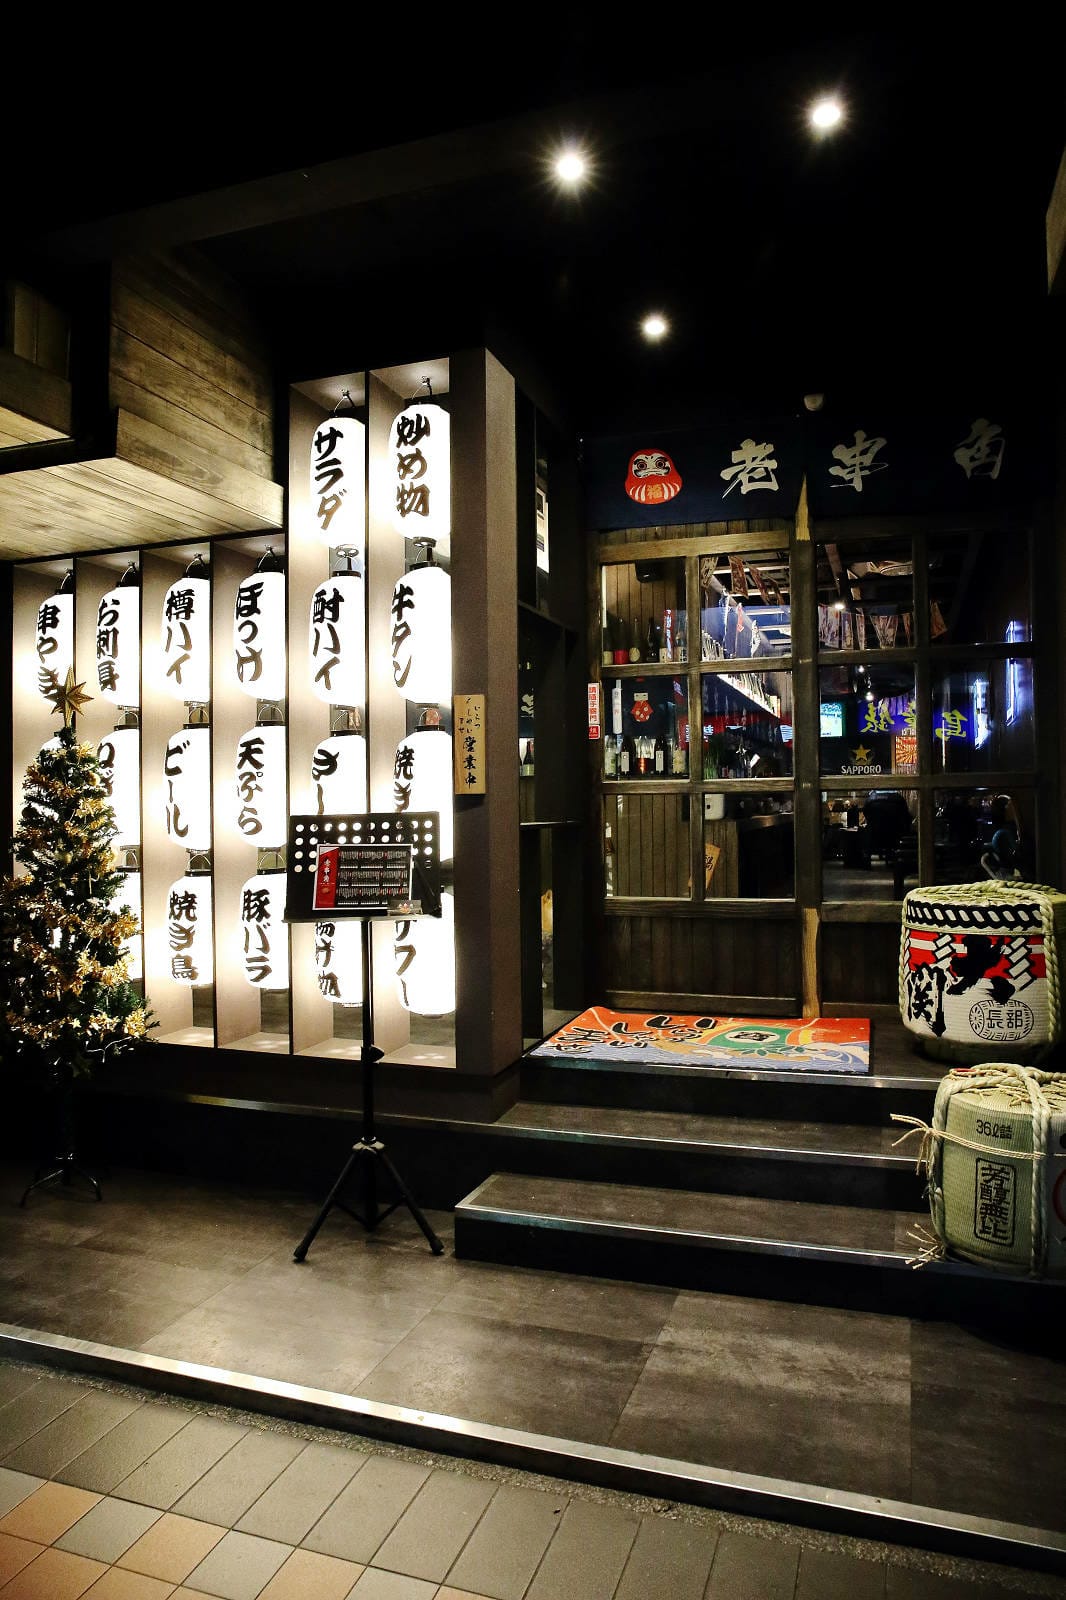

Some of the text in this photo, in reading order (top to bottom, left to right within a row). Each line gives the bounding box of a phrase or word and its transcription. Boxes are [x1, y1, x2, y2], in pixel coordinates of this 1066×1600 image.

[314, 426, 348, 531] サラダ
[395, 413, 431, 518] 炒め物
[96, 597, 121, 692] お刺身
[164, 588, 196, 685] 樽ハイ
[312, 587, 345, 691] 酎ハイ
[391, 583, 416, 688] 牛タン
[164, 739, 191, 838] ビール
[236, 737, 265, 836] 天ぷら
[841, 764, 882, 775] SAPPORO
[168, 889, 199, 981] 焼き鳥
[241, 888, 272, 983] 豚バラ
